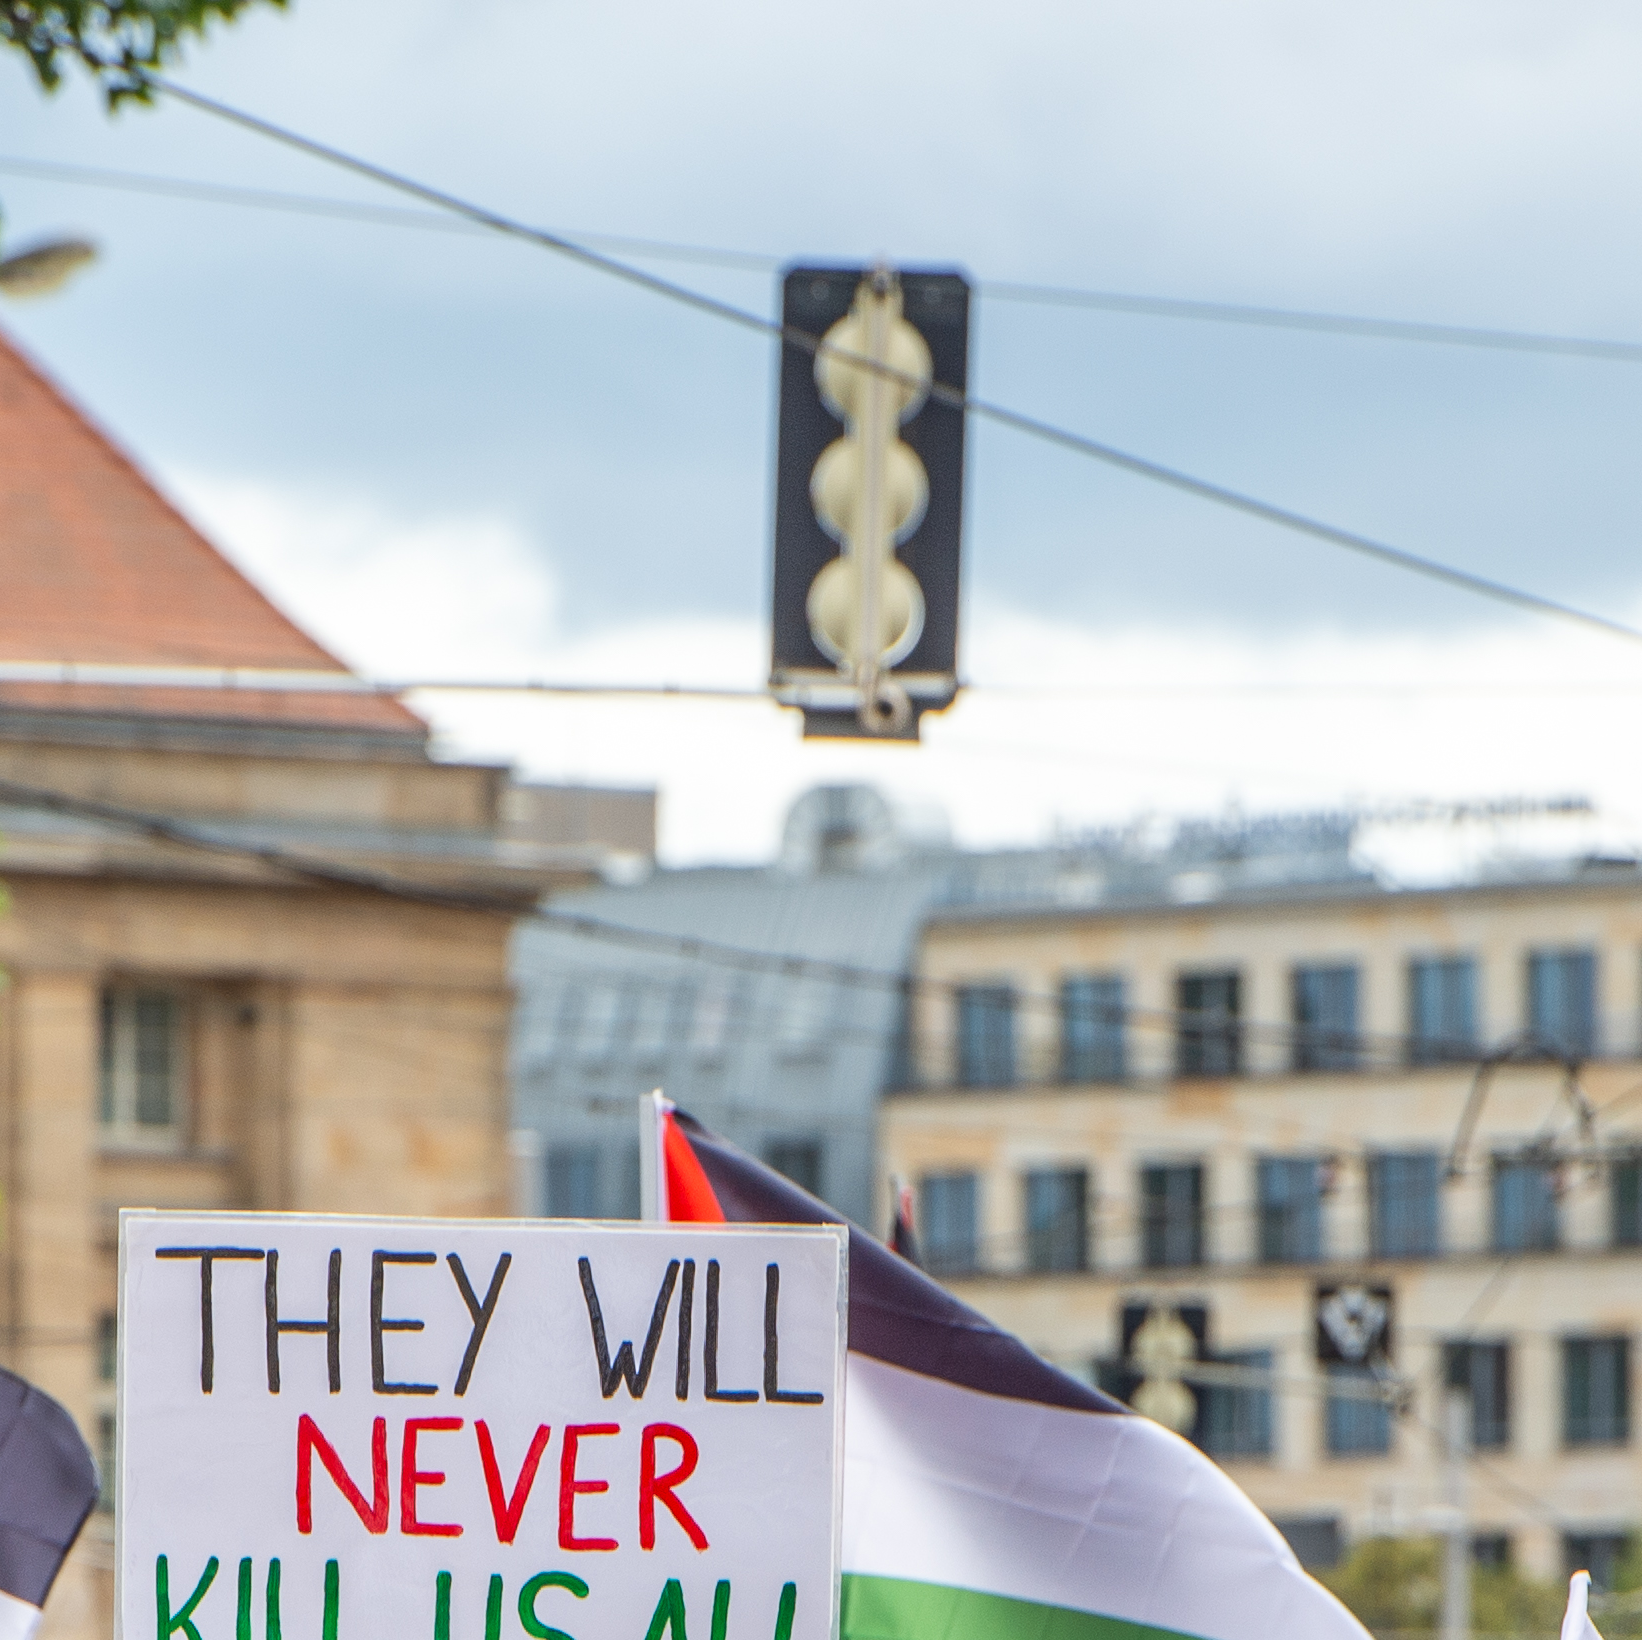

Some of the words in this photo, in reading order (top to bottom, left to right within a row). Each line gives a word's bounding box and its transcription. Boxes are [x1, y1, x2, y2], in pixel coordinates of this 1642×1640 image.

[155, 1247, 513, 1396] THEY
[578, 1256, 824, 1404] WILL
[296, 1413, 710, 1553] NEVER
